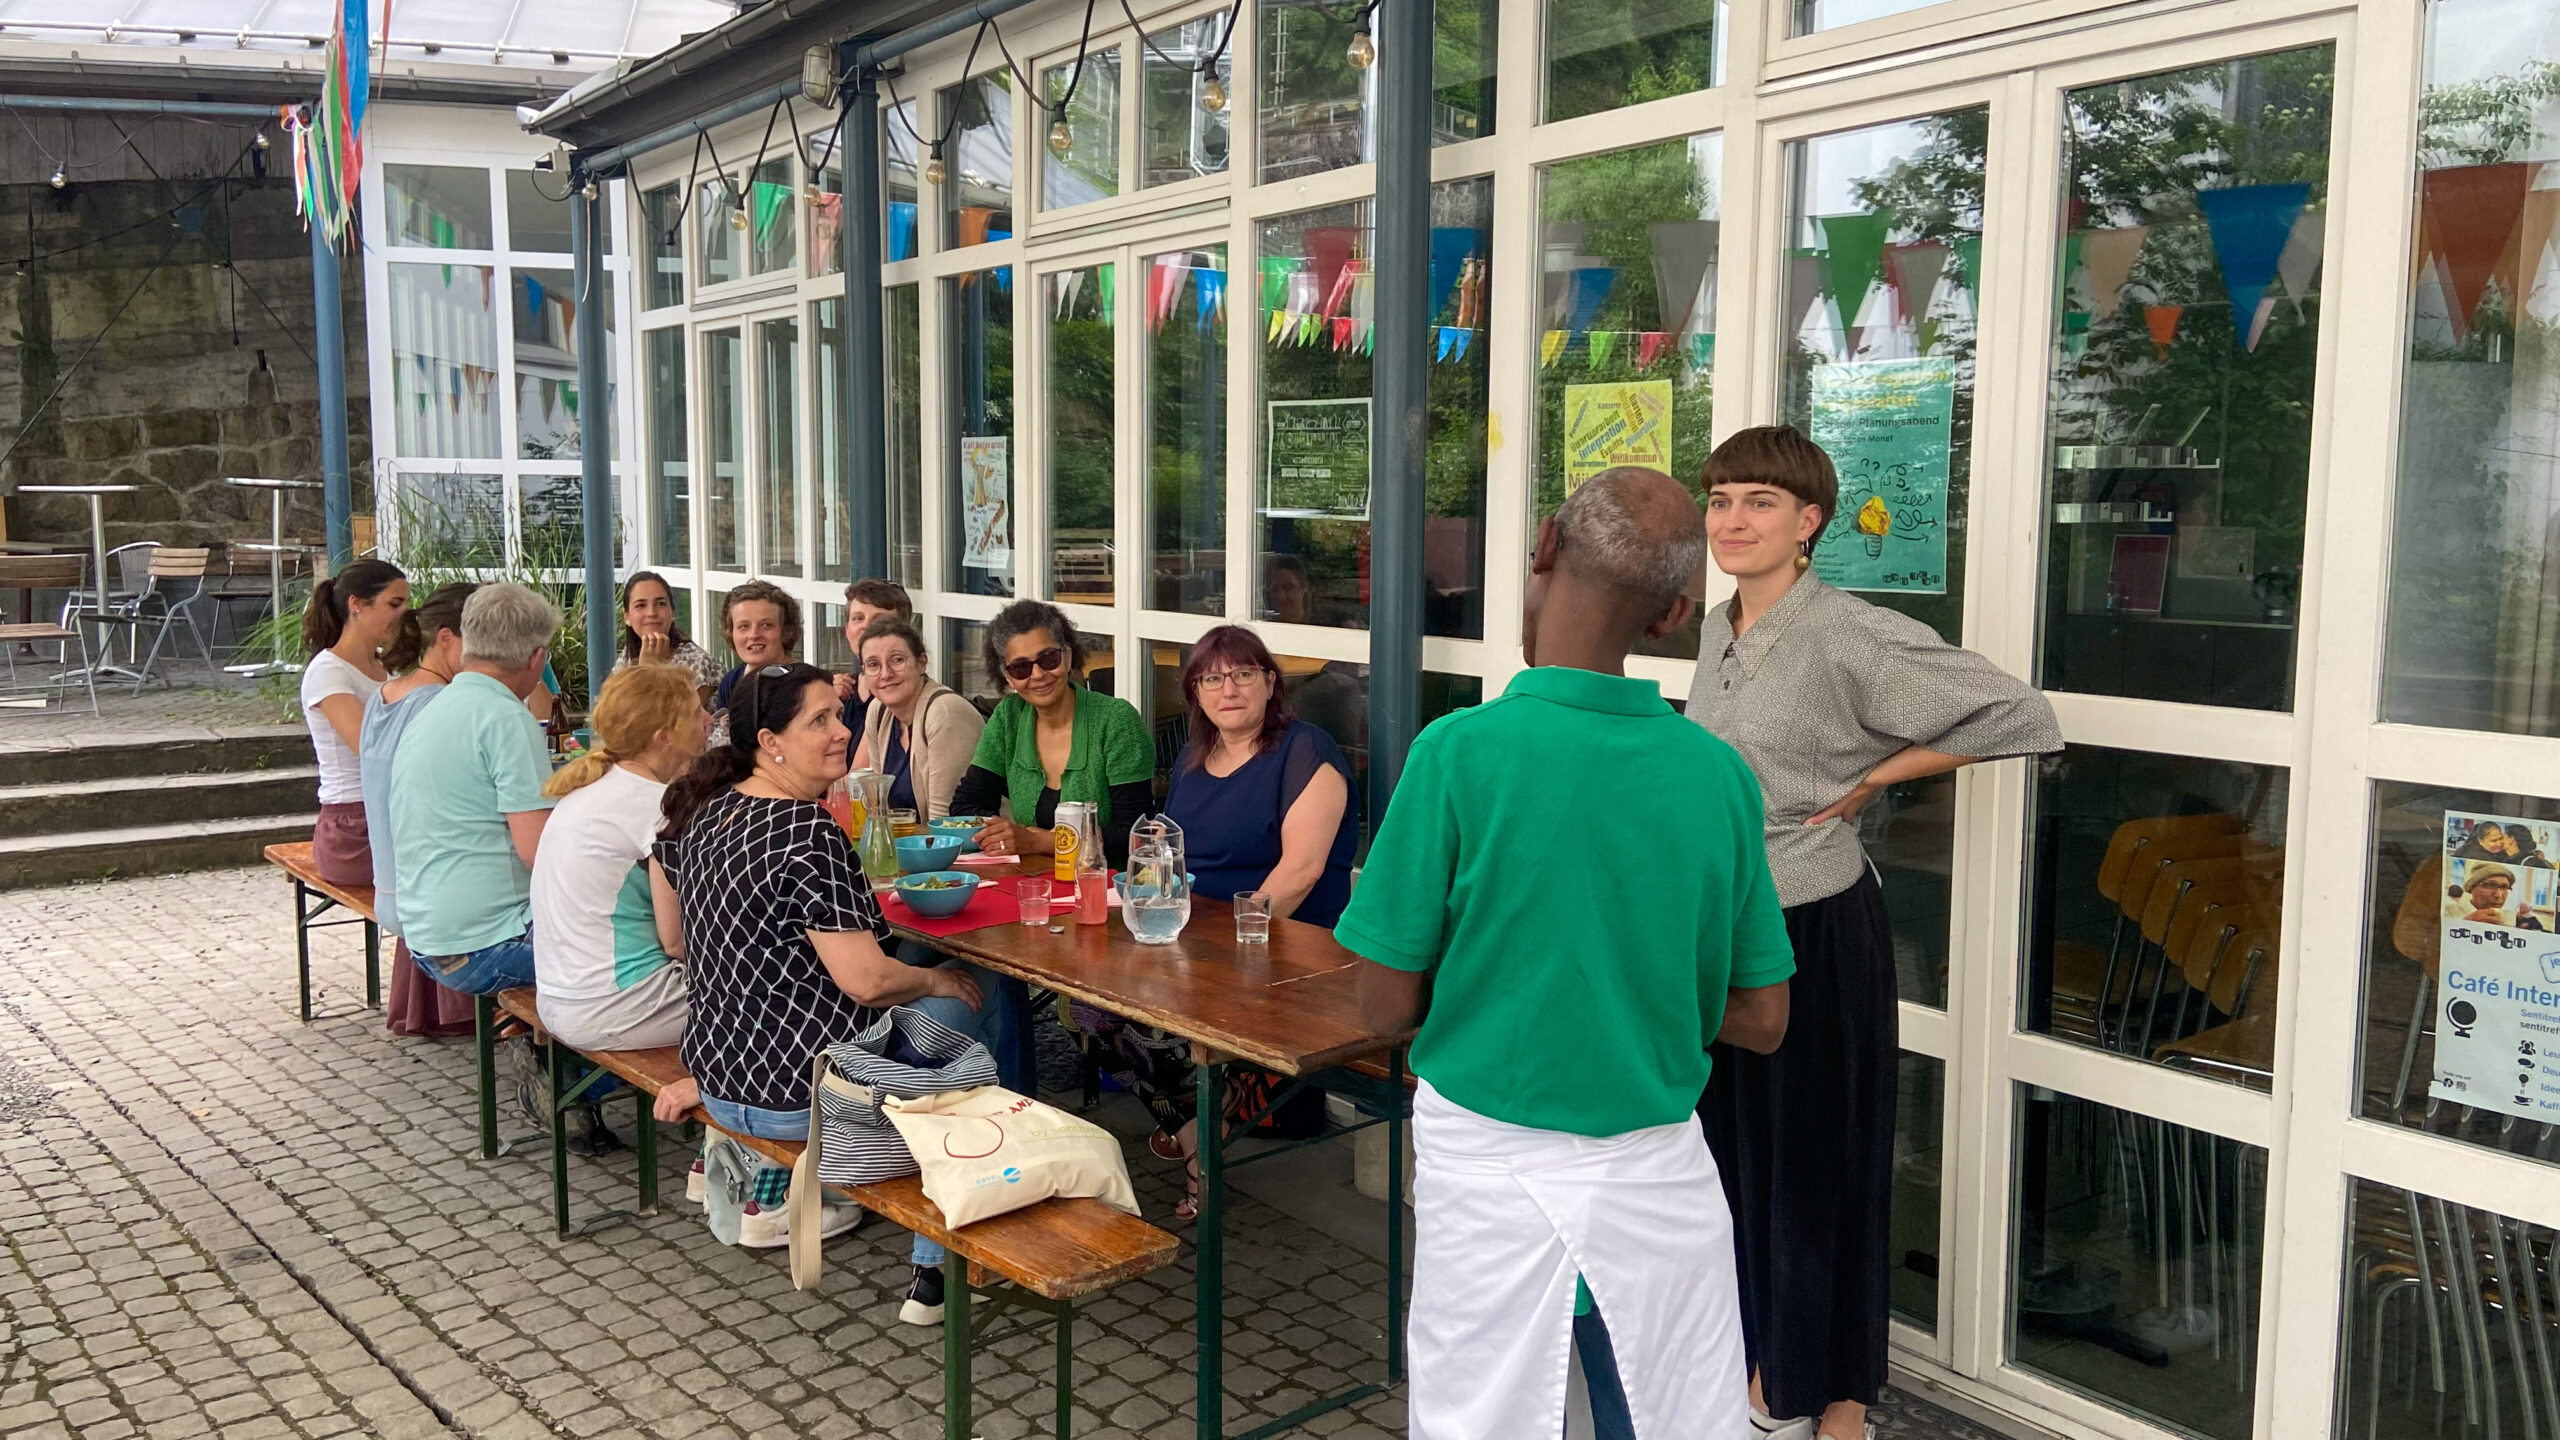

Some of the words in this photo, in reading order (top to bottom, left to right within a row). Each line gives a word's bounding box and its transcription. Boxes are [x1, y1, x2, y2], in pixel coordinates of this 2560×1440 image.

[1629, 393, 1645, 426] Garten
[1858, 415, 1940, 429] Planungsabend
[1578, 418, 1627, 461] Integration
[1600, 436, 1625, 459] Events
[1868, 434, 1894, 443] Monat
[2448, 970, 2500, 996] Café
[2507, 981, 2560, 1008] Inter
